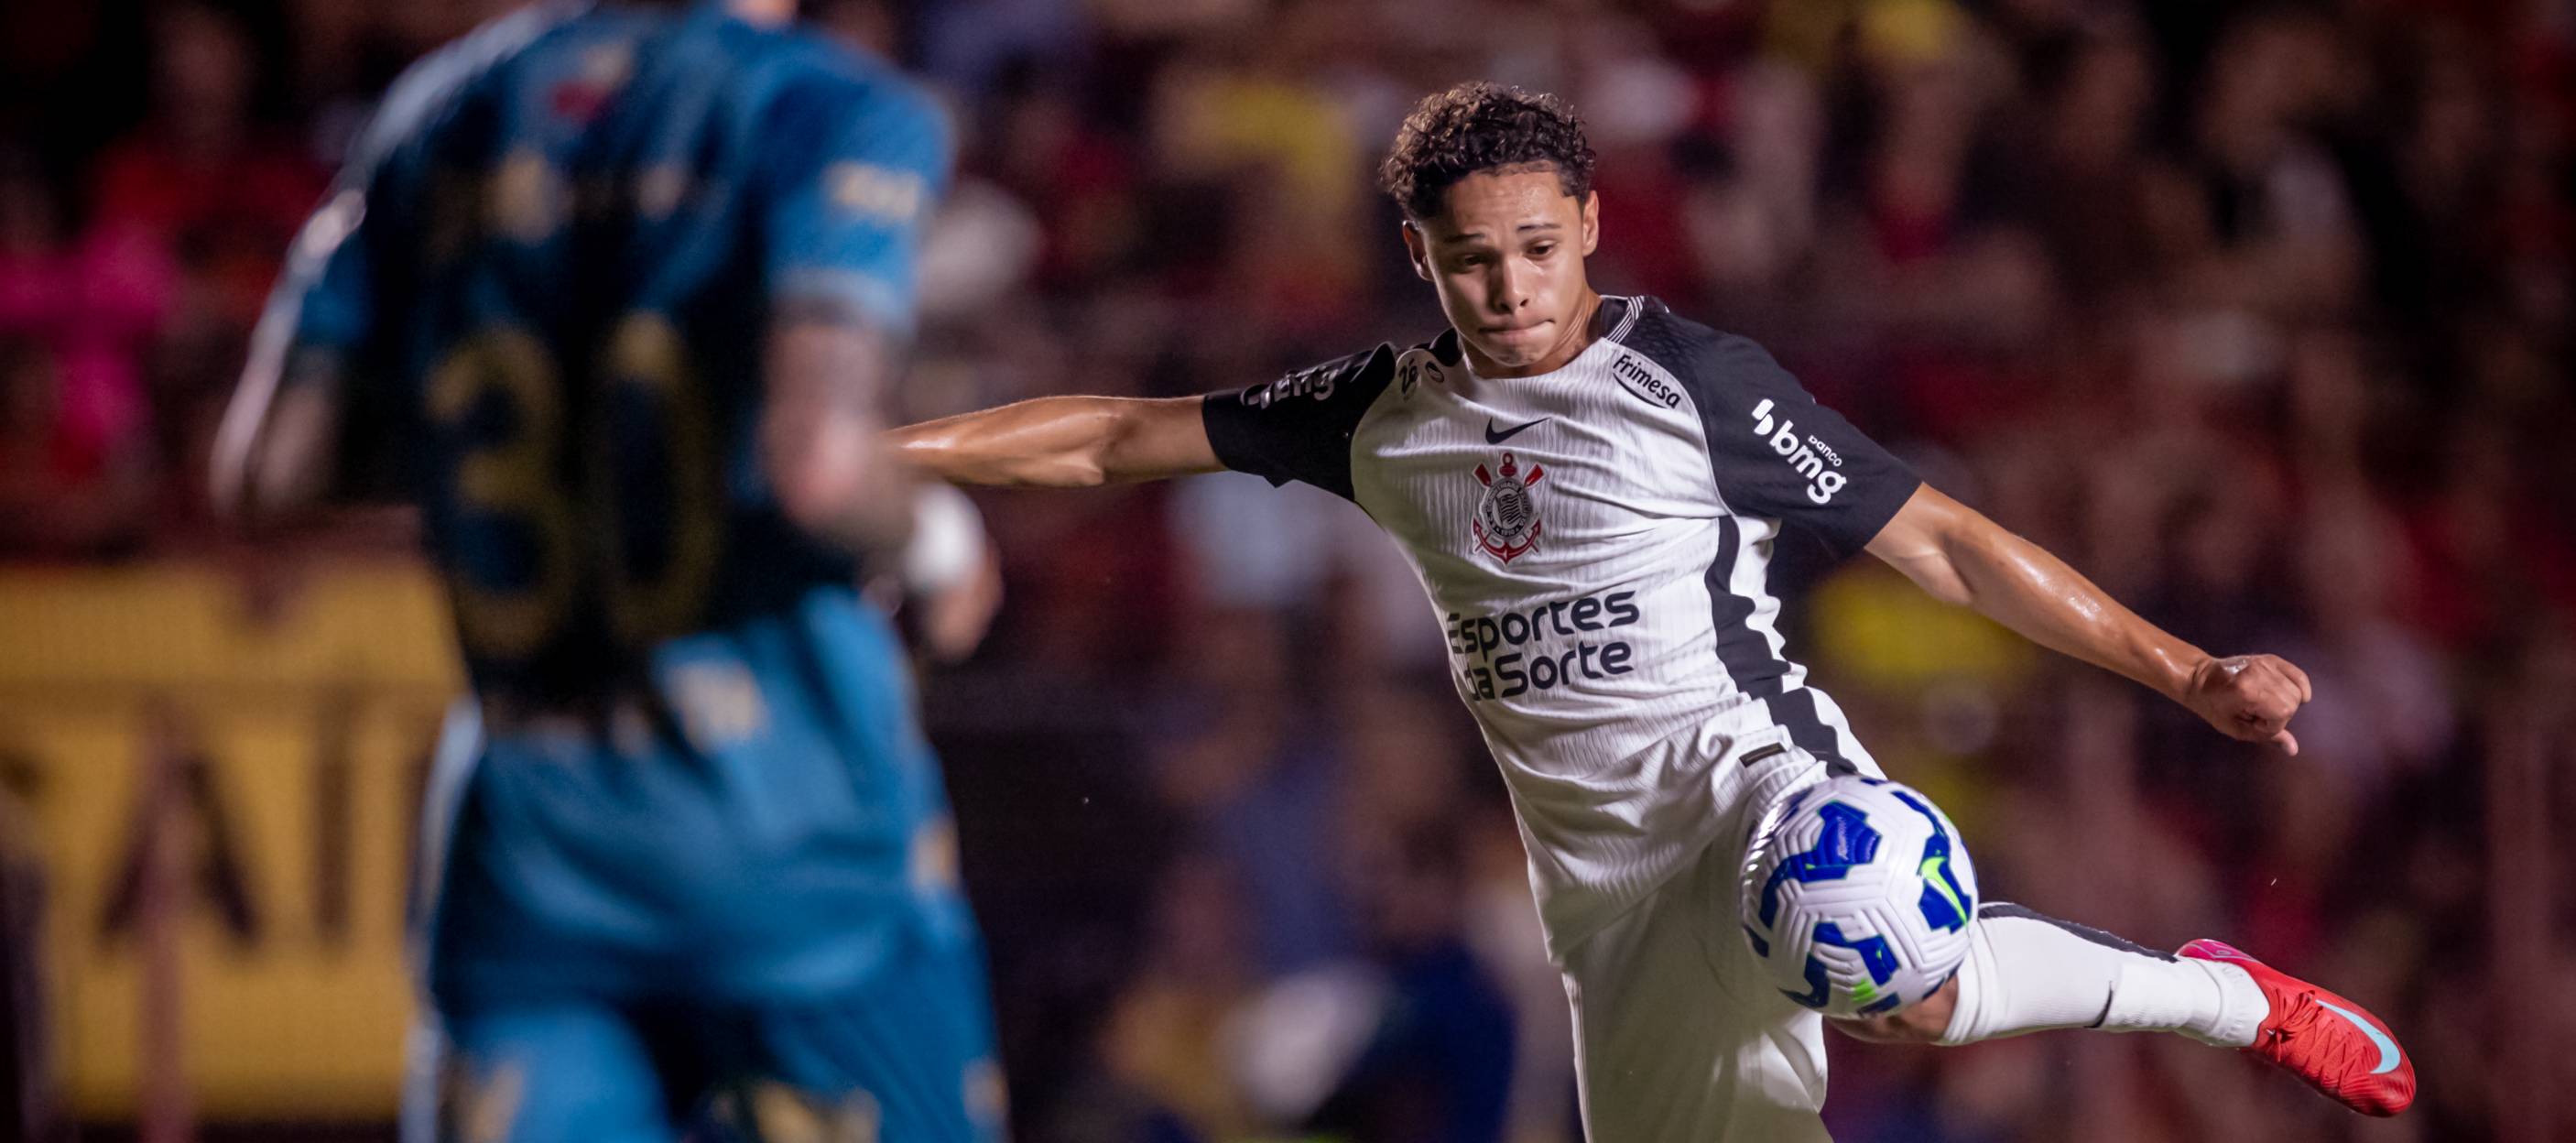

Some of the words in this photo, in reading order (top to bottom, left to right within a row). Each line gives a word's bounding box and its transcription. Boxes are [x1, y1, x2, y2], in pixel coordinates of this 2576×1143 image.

[1613, 354, 1681, 409] Frimesa
[1769, 419, 1847, 504] bmg
[1809, 435, 1842, 467] banco
[419, 310, 727, 661] 30
[1448, 590, 1640, 662] Esportes
[1495, 641, 1634, 698] Sorte
